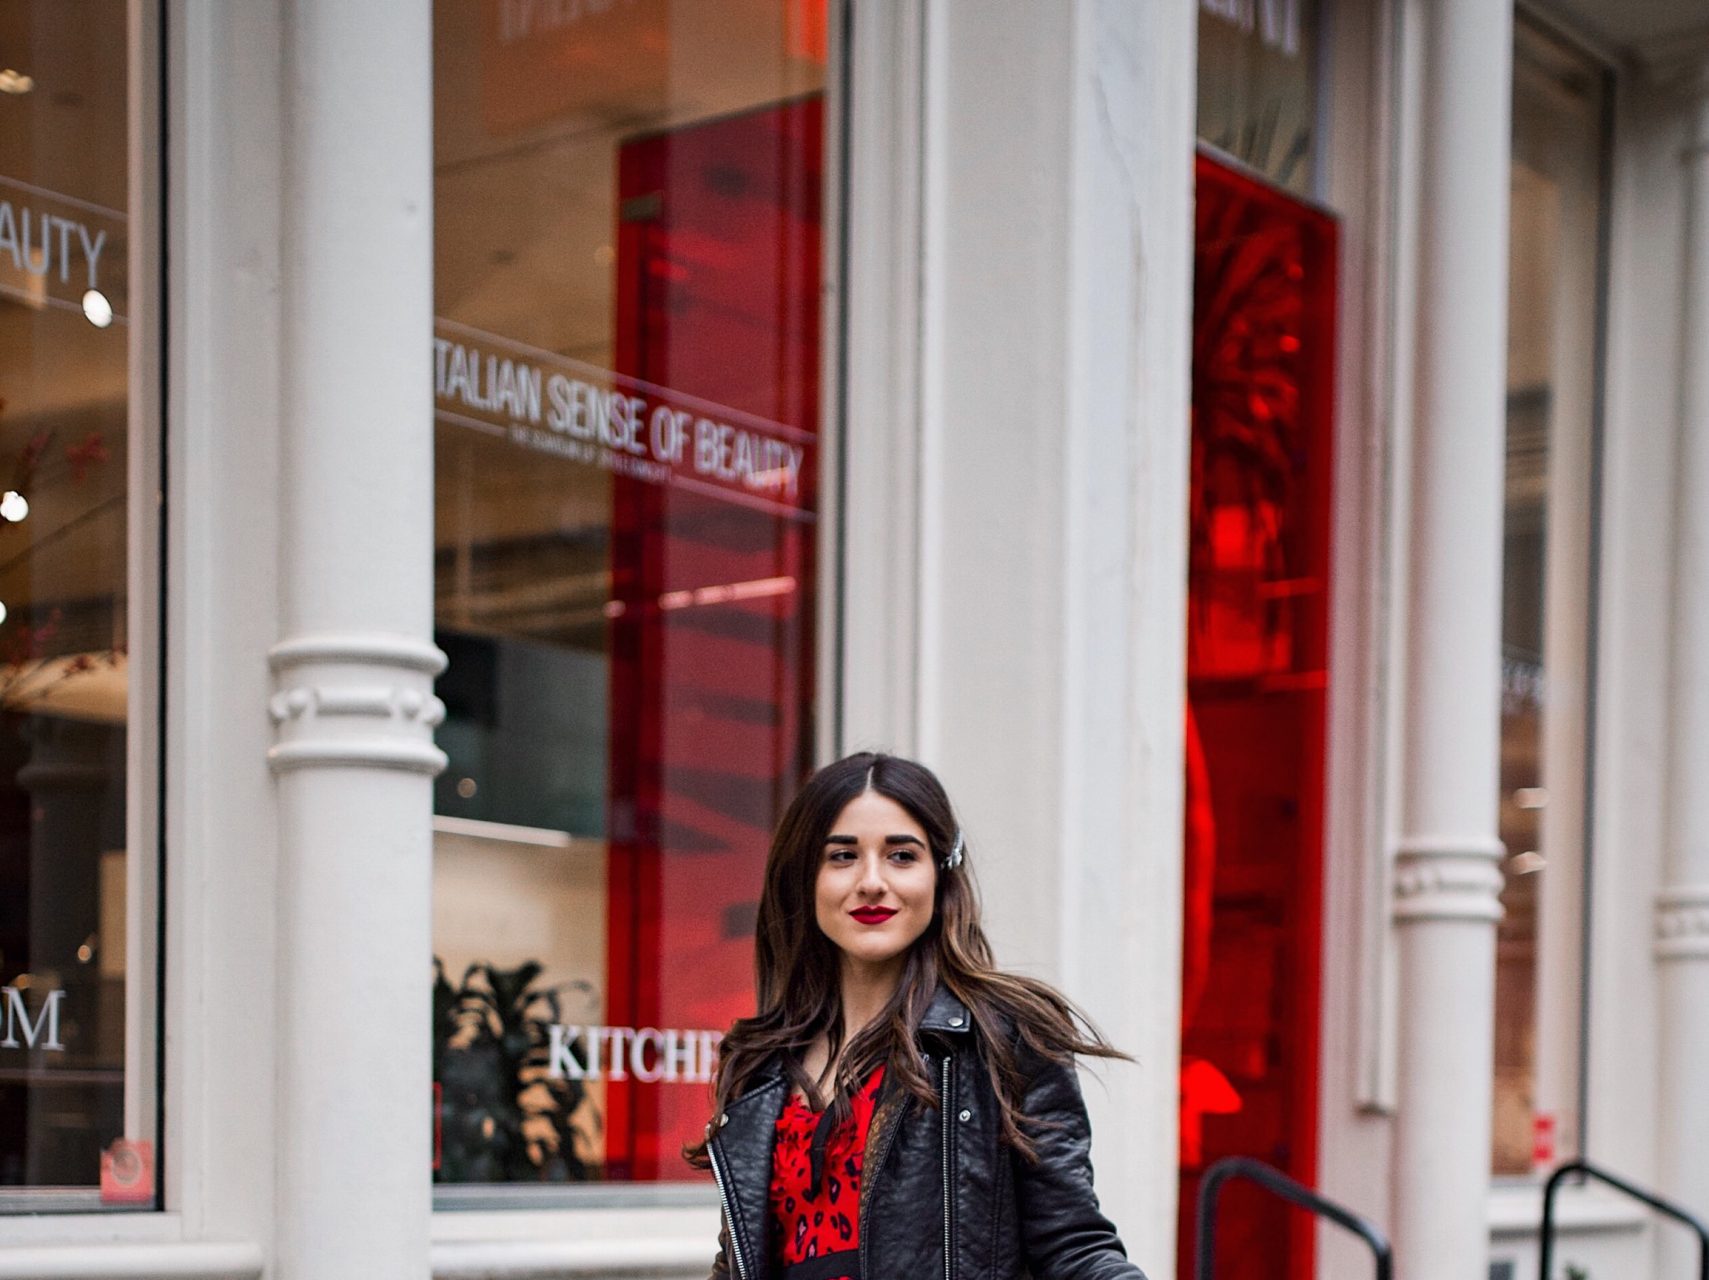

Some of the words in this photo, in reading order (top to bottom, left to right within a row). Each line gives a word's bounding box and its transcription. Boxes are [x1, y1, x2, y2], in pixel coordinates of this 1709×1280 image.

[0, 201, 107, 289] AUTY
[435, 337, 542, 425] TALIAN
[547, 373, 648, 455] SENSE
[651, 405, 693, 465] OF
[694, 417, 804, 498] BEAUTY
[0, 985, 67, 1051] M
